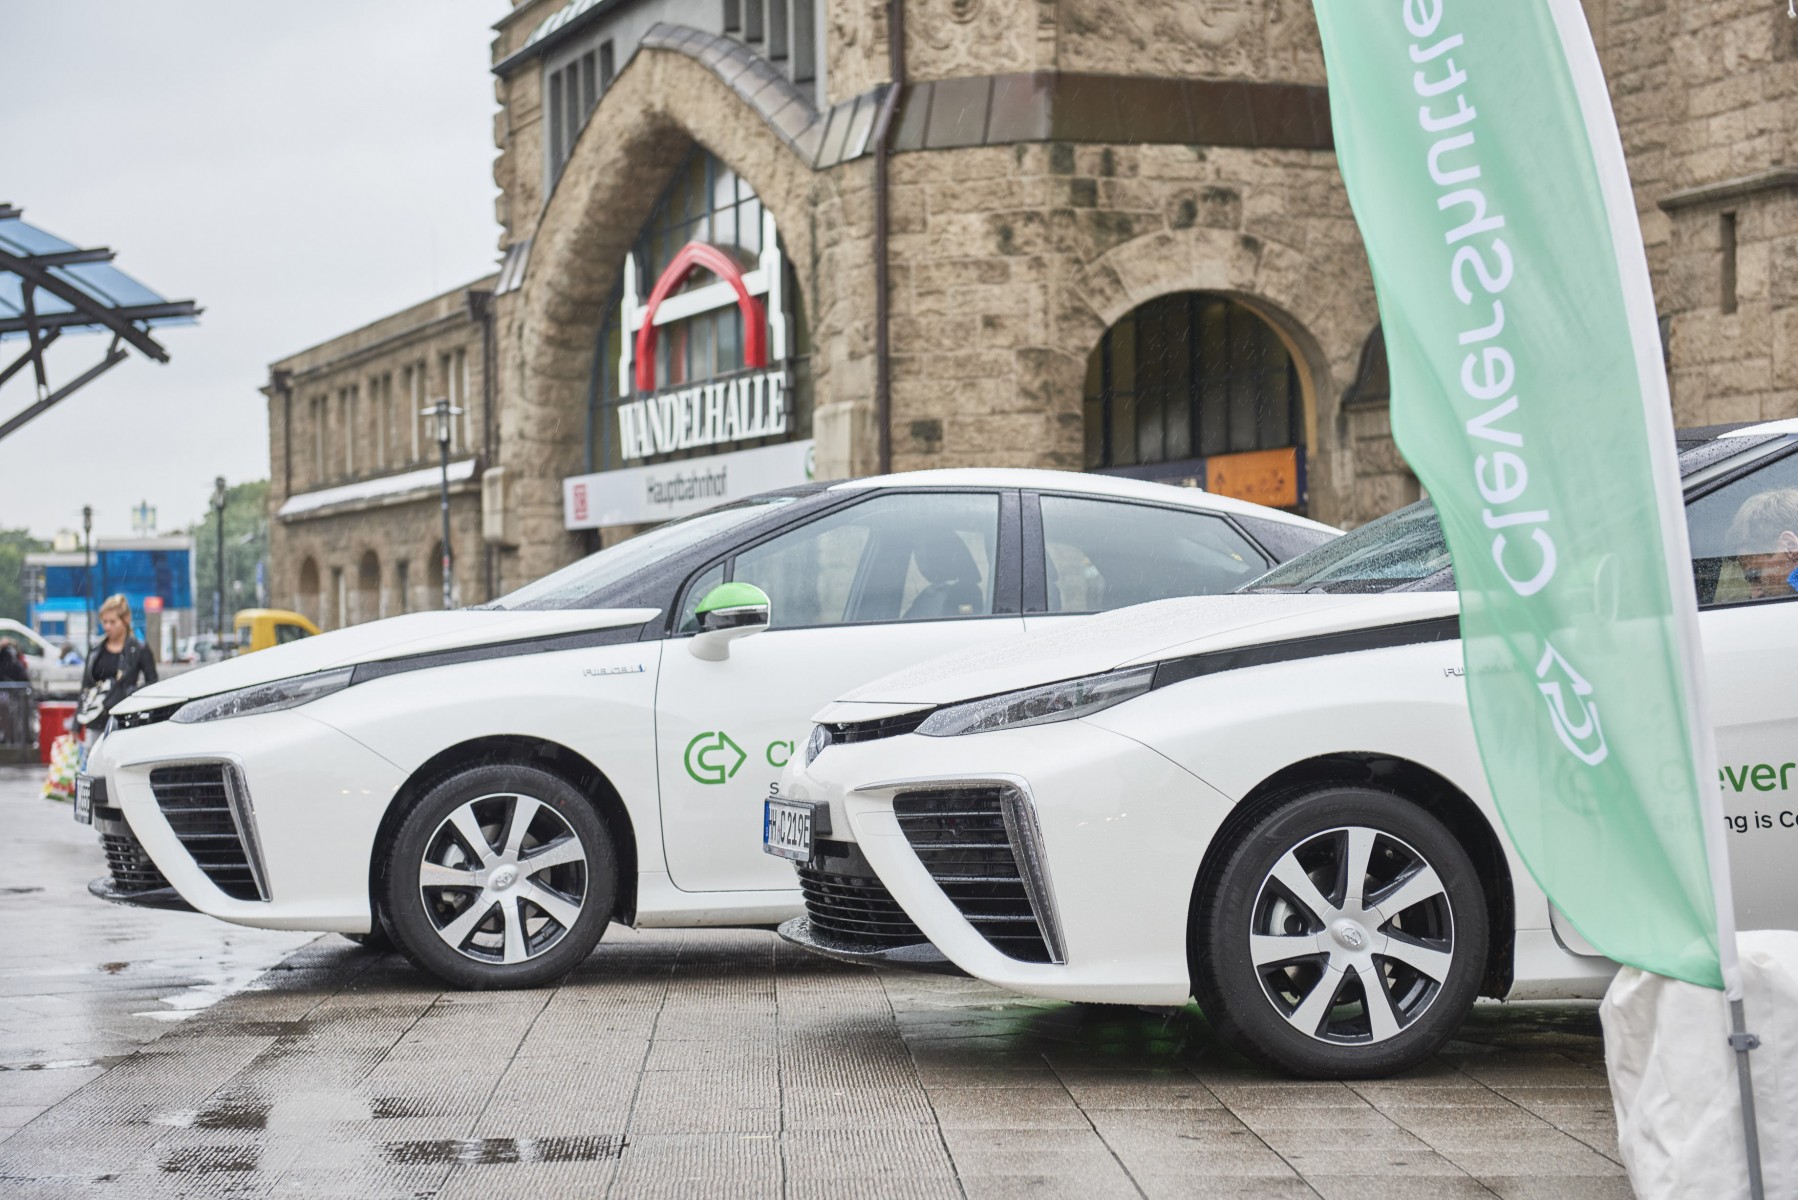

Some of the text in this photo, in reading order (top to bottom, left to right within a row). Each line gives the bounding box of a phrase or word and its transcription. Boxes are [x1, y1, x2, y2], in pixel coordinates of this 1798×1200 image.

[618, 371, 787, 460] WANDELHALLE
[646, 465, 727, 508] Hauptbahnhof
[766, 740, 795, 767] Cl
[1718, 762, 1797, 792] ver
[1724, 815, 1748, 834] ng
[1754, 810, 1773, 829] is
